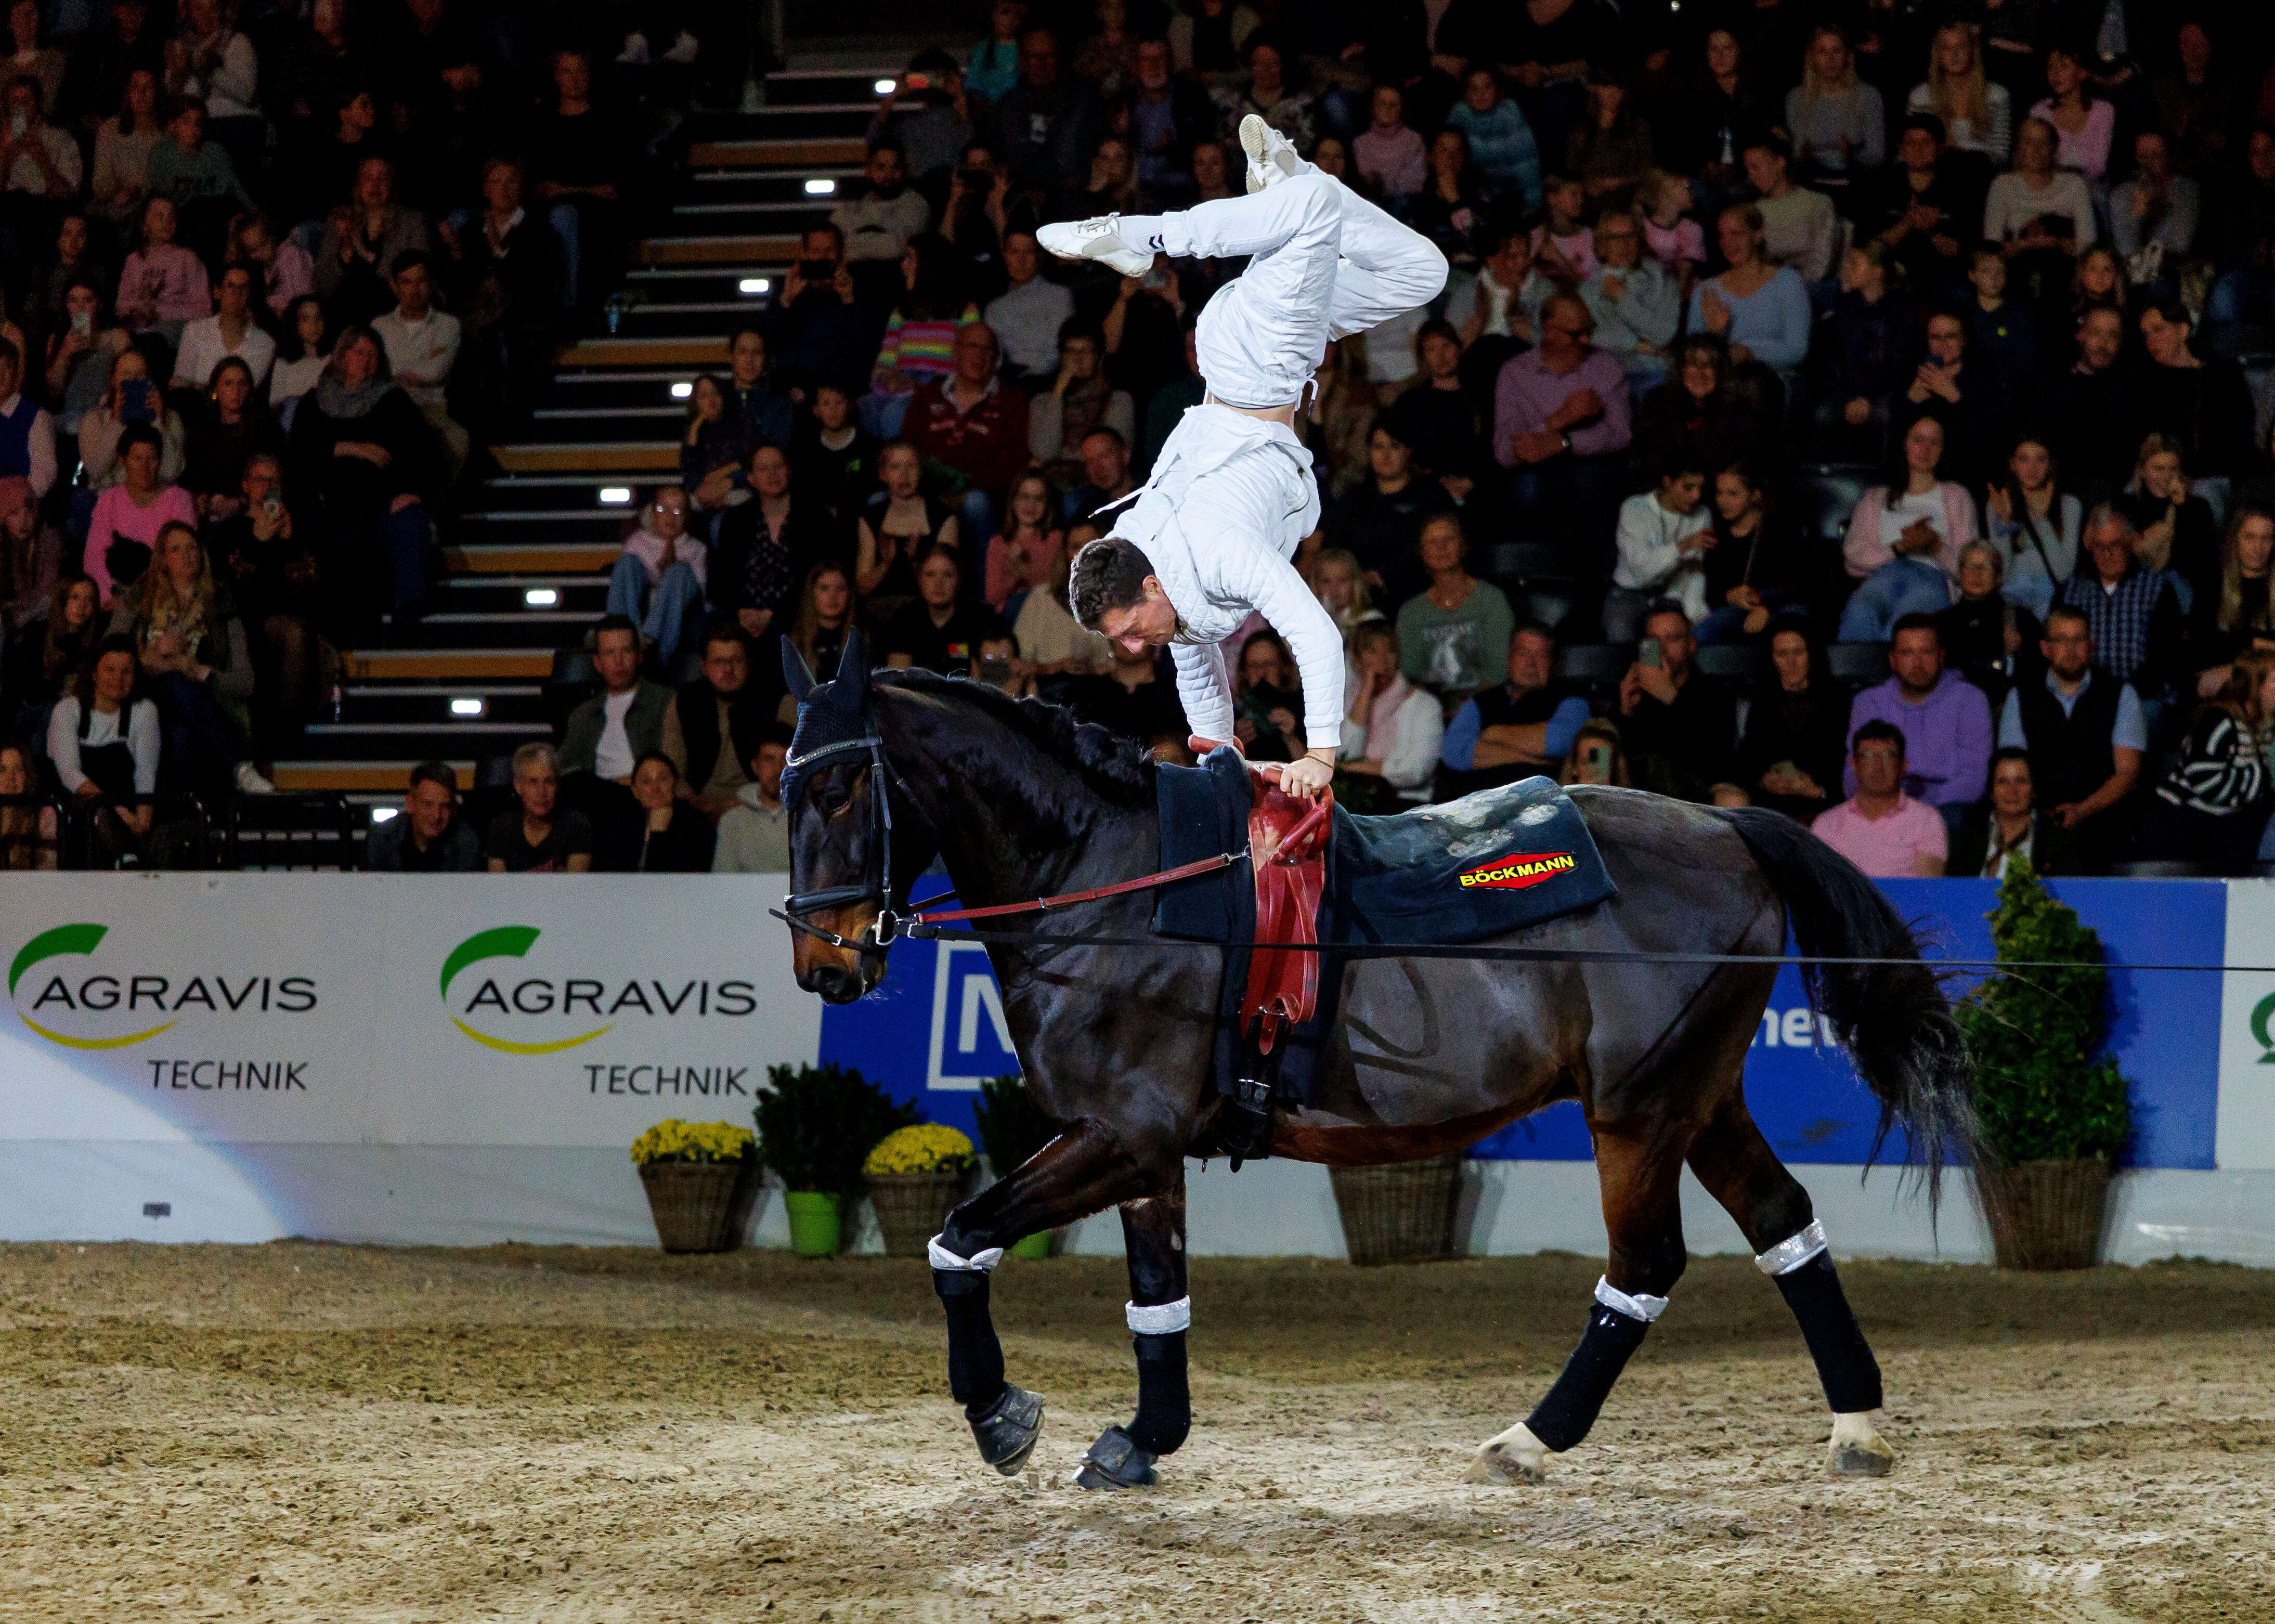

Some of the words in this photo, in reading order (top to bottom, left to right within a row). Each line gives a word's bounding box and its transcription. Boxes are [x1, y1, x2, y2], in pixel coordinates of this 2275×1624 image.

[1460, 856, 1575, 887] BÖCKMANN
[32, 976, 318, 1011] AGRAVIS
[465, 978, 757, 1016] AGRAVIS
[148, 1059, 309, 1091] TECHNIK
[583, 1064, 748, 1096] TECHNIK
